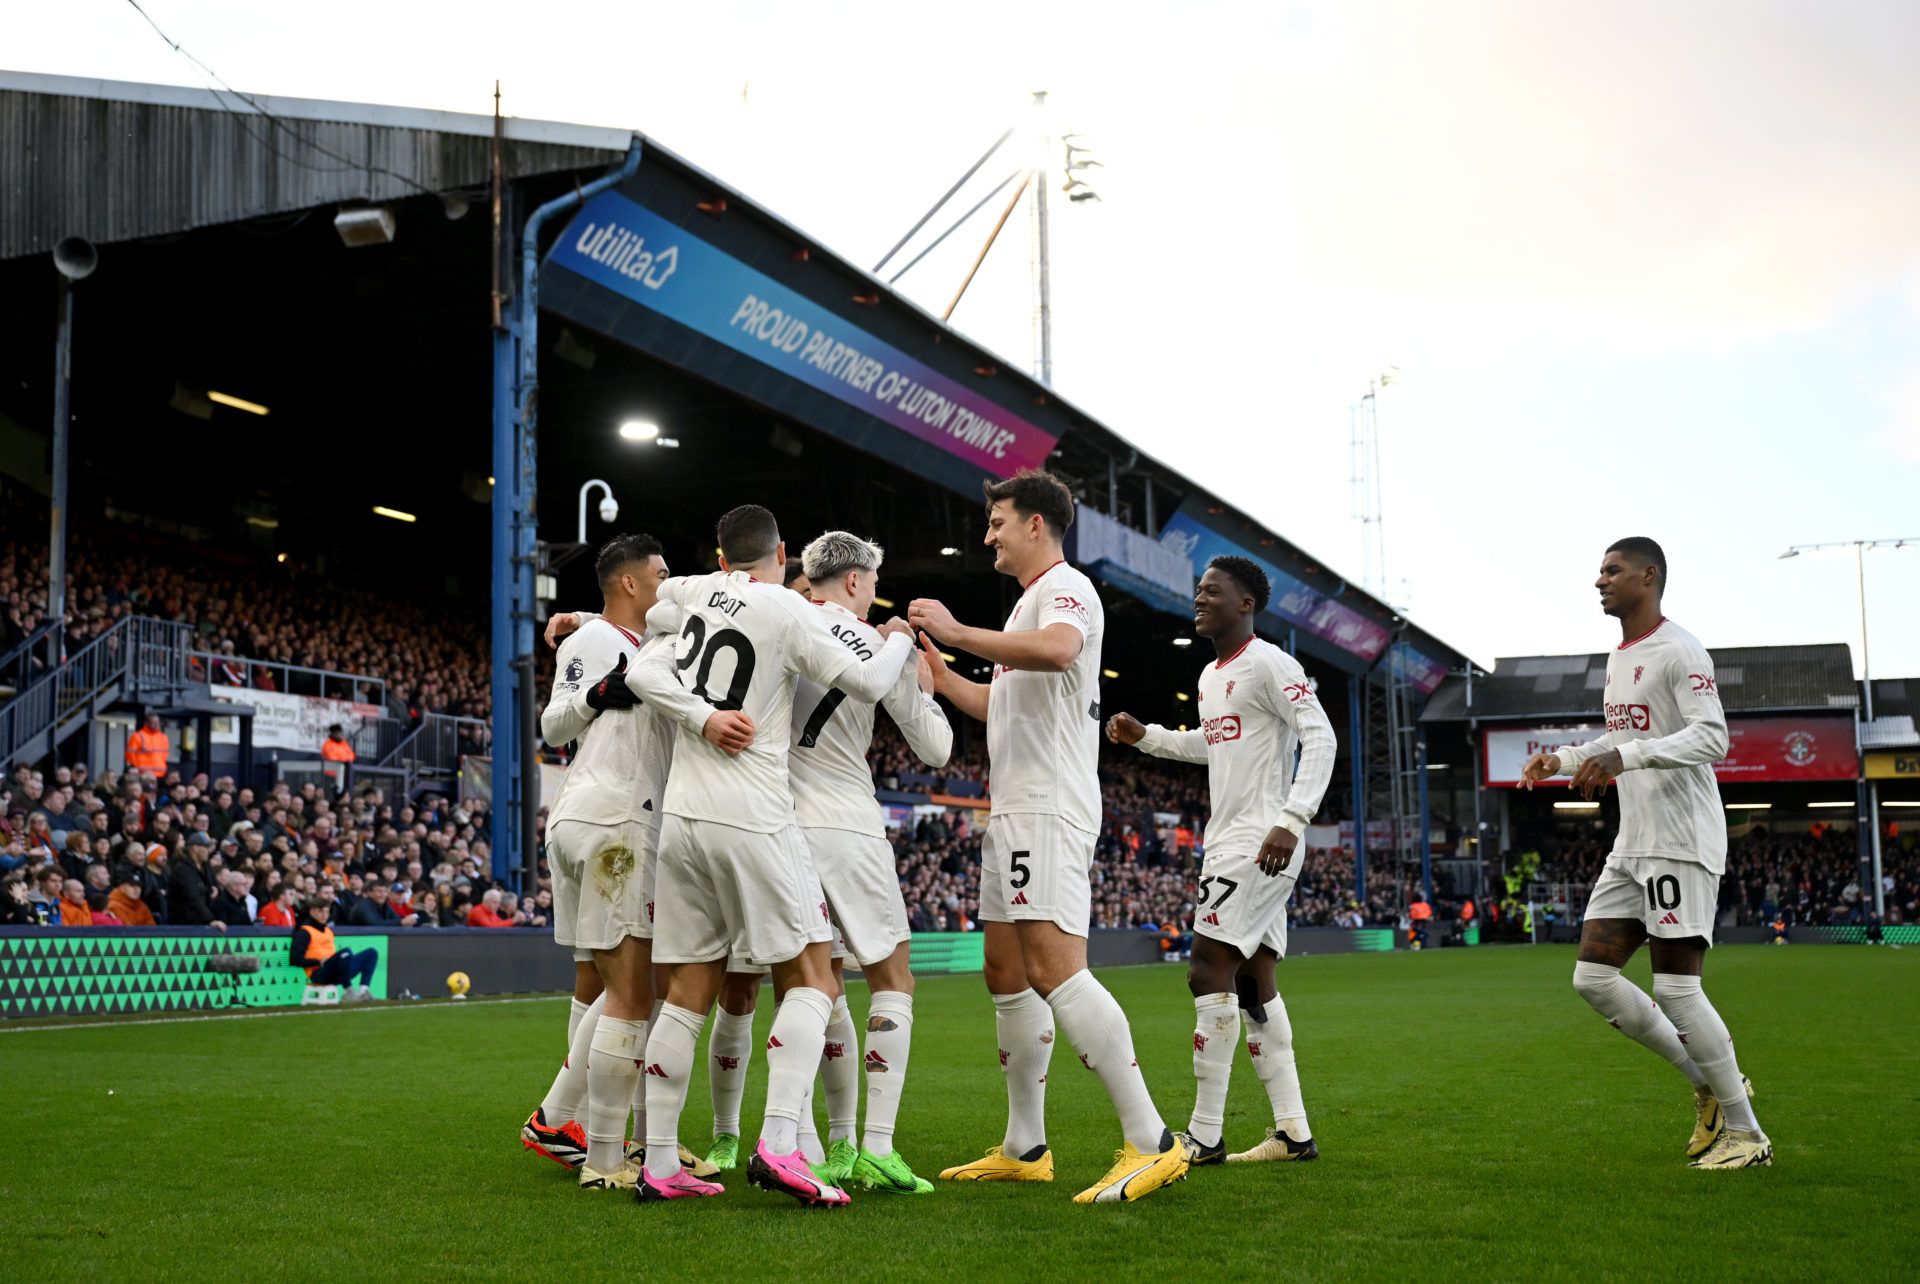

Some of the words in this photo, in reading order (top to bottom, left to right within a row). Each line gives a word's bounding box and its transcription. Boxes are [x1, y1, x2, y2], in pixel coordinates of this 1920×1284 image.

[576, 223, 653, 281] utilita
[730, 294, 808, 353] PROUD
[798, 330, 884, 393] PARTNER
[876, 371, 909, 404] OF
[897, 382, 957, 429] LUTON
[946, 406, 998, 450] TOWN
[986, 429, 1016, 458] FC
[676, 614, 756, 711] 20
[830, 624, 873, 662] ACHO
[1010, 850, 1031, 889] 5
[1646, 874, 1681, 911] 10
